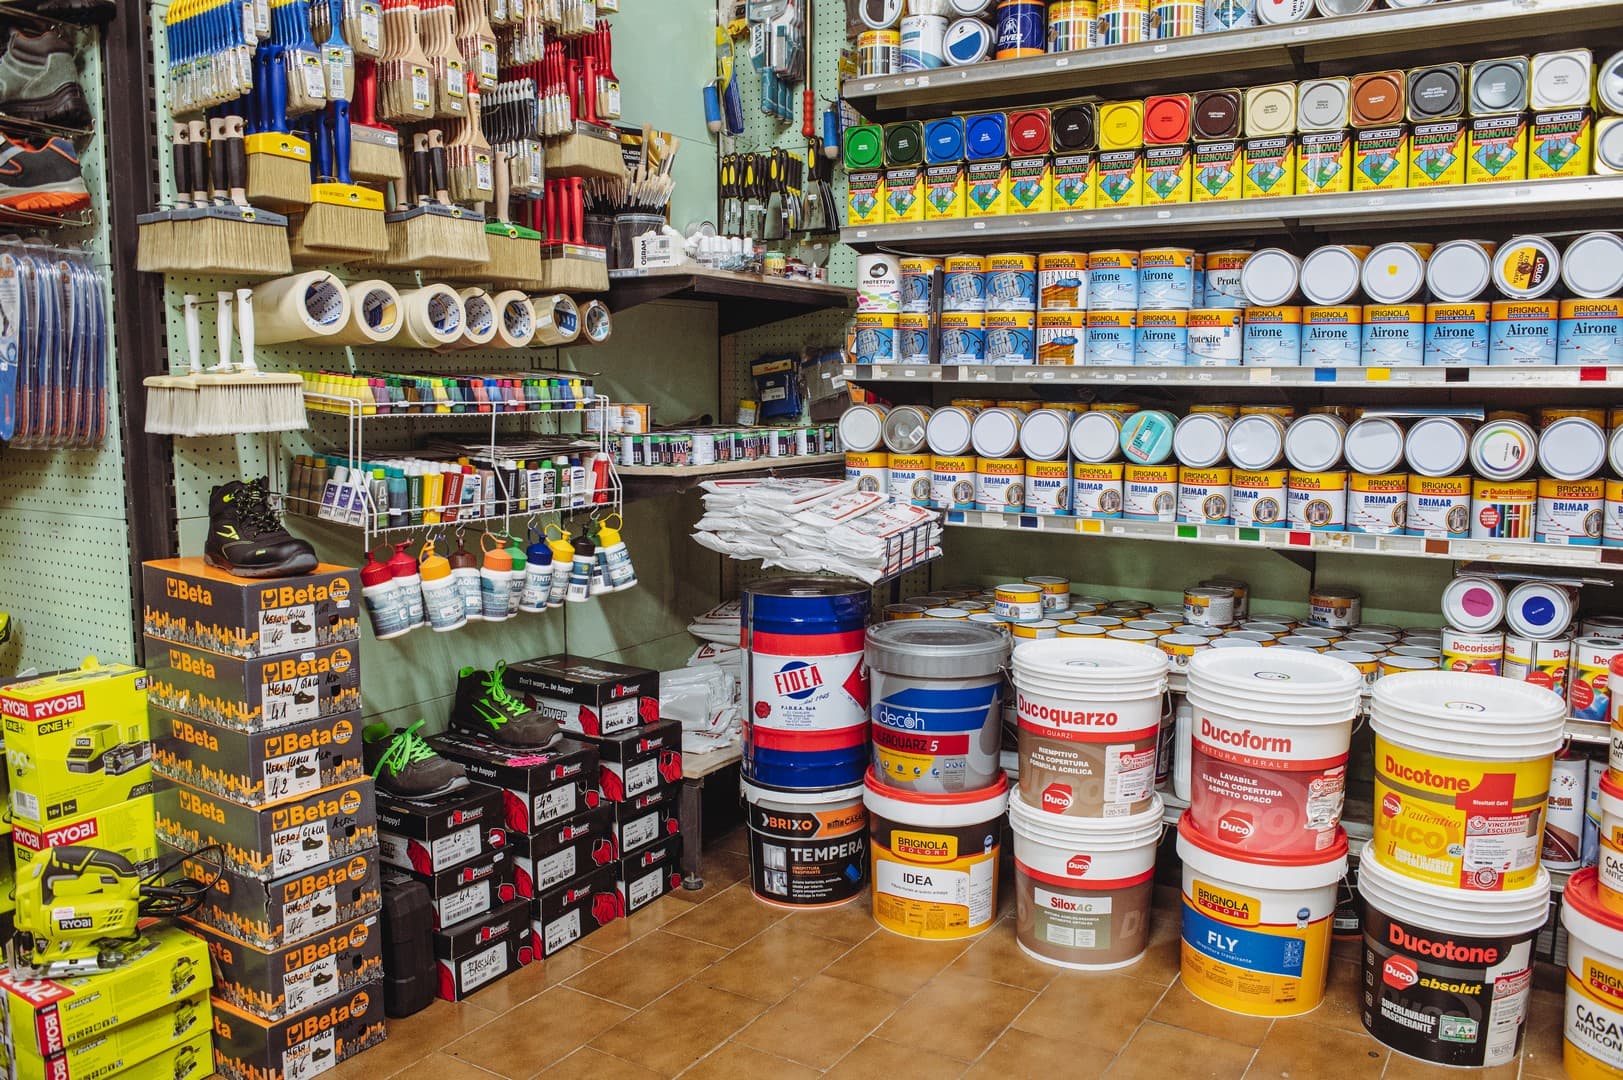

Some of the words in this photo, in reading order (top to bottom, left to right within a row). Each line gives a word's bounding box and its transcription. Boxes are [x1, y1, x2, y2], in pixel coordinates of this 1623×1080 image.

[1474, 128, 1518, 138] FERNOVUS
[1536, 123, 1581, 134] FERNOVUS
[1359, 140, 1399, 149] FERNOVUS
[1415, 134, 1457, 144] FERNOVUS
[1303, 144, 1342, 153] FERNOVUS
[1090, 256, 1120, 264] BRIGNOLA
[1090, 272, 1120, 282] Airone
[1142, 270, 1174, 280] Airone
[1248, 310, 1282, 318] BRIGNOLA
[1508, 306, 1550, 314] BRIGNOLA
[1574, 304, 1618, 312] BRIGNOLA
[1191, 314, 1220, 322] BRIGNOLA
[1142, 330, 1176, 340] Airone
[1248, 328, 1282, 338] Airone
[1310, 328, 1348, 338] Airone
[1370, 326, 1409, 338] Airone
[1434, 326, 1474, 338] Airone
[1507, 324, 1548, 336] Airone
[1573, 322, 1616, 334] Airone
[1090, 331, 1119, 340] Airone
[894, 458, 924, 466] BRIGNOLA
[892, 472, 916, 480] BRIMAR
[934, 474, 956, 482] BRIMAR
[1133, 470, 1168, 478] BRIGNOLA
[1184, 472, 1218, 480] BRIGNOLA
[1034, 480, 1060, 488] BRIMAR
[1422, 482, 1462, 490] BRIGNOLA
[1182, 487, 1208, 496] BRIMAR
[1234, 490, 1258, 499] BRIMAR
[1364, 496, 1398, 504] BRIMAR
[1418, 498, 1452, 507] BRIMAR
[1553, 502, 1589, 512] BRIMAR
[179, 580, 212, 606] Beta
[280, 584, 328, 606] Beta
[181, 652, 215, 679] Beta
[282, 658, 330, 680] Beta
[774, 666, 823, 694] FIDEA
[558, 684, 574, 694] happy!
[623, 684, 640, 696] Power
[2, 699, 28, 718] RYOBI
[34, 694, 82, 718] RYOBI
[536, 701, 568, 720] Power
[1019, 694, 1118, 726] Ducoquarzo
[880, 706, 925, 730] decoh
[38, 720, 72, 736] ONE+
[1046, 730, 1072, 739] QUARZI
[1202, 718, 1292, 752] Ducoform
[76, 738, 90, 746] RYOBI
[184, 724, 218, 752] Beta
[284, 729, 332, 752] Beta
[930, 740, 939, 752] 5
[1039, 747, 1078, 758] RIEMPITIVO
[1032, 752, 1046, 762] ALTA
[1046, 756, 1089, 768] COPERTURA
[1202, 745, 1236, 761] PITTURA
[1244, 757, 1289, 769] MURALE
[479, 766, 496, 778] happy!
[564, 762, 582, 776] Power
[1030, 760, 1056, 772] FORMULA
[1058, 765, 1092, 776] ACRILICA
[1386, 754, 1470, 792] Ducotone
[1203, 774, 1230, 789] ELEVATA
[1232, 784, 1282, 797] COPERTURA
[1220, 772, 1258, 786] LAVABILE
[271, 779, 289, 797] 42
[1208, 785, 1240, 799] ASPETTO
[1242, 794, 1272, 804] OPACO
[1044, 794, 1069, 806] Duco
[190, 794, 225, 824] Beta
[290, 800, 338, 826] Beta
[462, 806, 484, 821] Power
[1384, 800, 1399, 812] Duco
[1403, 804, 1462, 828] l'autentico
[383, 815, 400, 826] happy!
[769, 816, 812, 831] BRIXO
[1220, 820, 1250, 835] Duco
[14, 828, 40, 848] RYOBI
[47, 822, 95, 846] RYOBI
[791, 838, 862, 862] TEMPERA
[898, 836, 948, 850] BRIGNOLA
[900, 846, 948, 856] COLORI
[195, 865, 230, 894] Beta
[302, 867, 347, 896] Beta
[903, 872, 932, 886] IDEA
[1198, 888, 1249, 912] BRIGNOLA
[1199, 900, 1248, 919] COLORI
[61, 919, 92, 928] RYOBI
[1208, 931, 1239, 952] FLY
[1390, 922, 1498, 964] Ducotone
[209, 941, 232, 964] eta
[302, 936, 349, 963] Beta
[1385, 963, 1414, 982] Duco
[1420, 976, 1481, 994] absolut
[1590, 968, 1623, 989] BRIGN
[1592, 980, 1618, 997] COL
[1382, 998, 1436, 1025] SUPERLAVABILE
[304, 1004, 349, 1038] Beta
[1382, 1007, 1432, 1034] MASCHERANTE
[1576, 1004, 1623, 1039] CASA
[46, 1014, 62, 1054] RYOBI
[1458, 1025, 1474, 1035] A+
[1576, 1021, 1622, 1051] ANTICON
